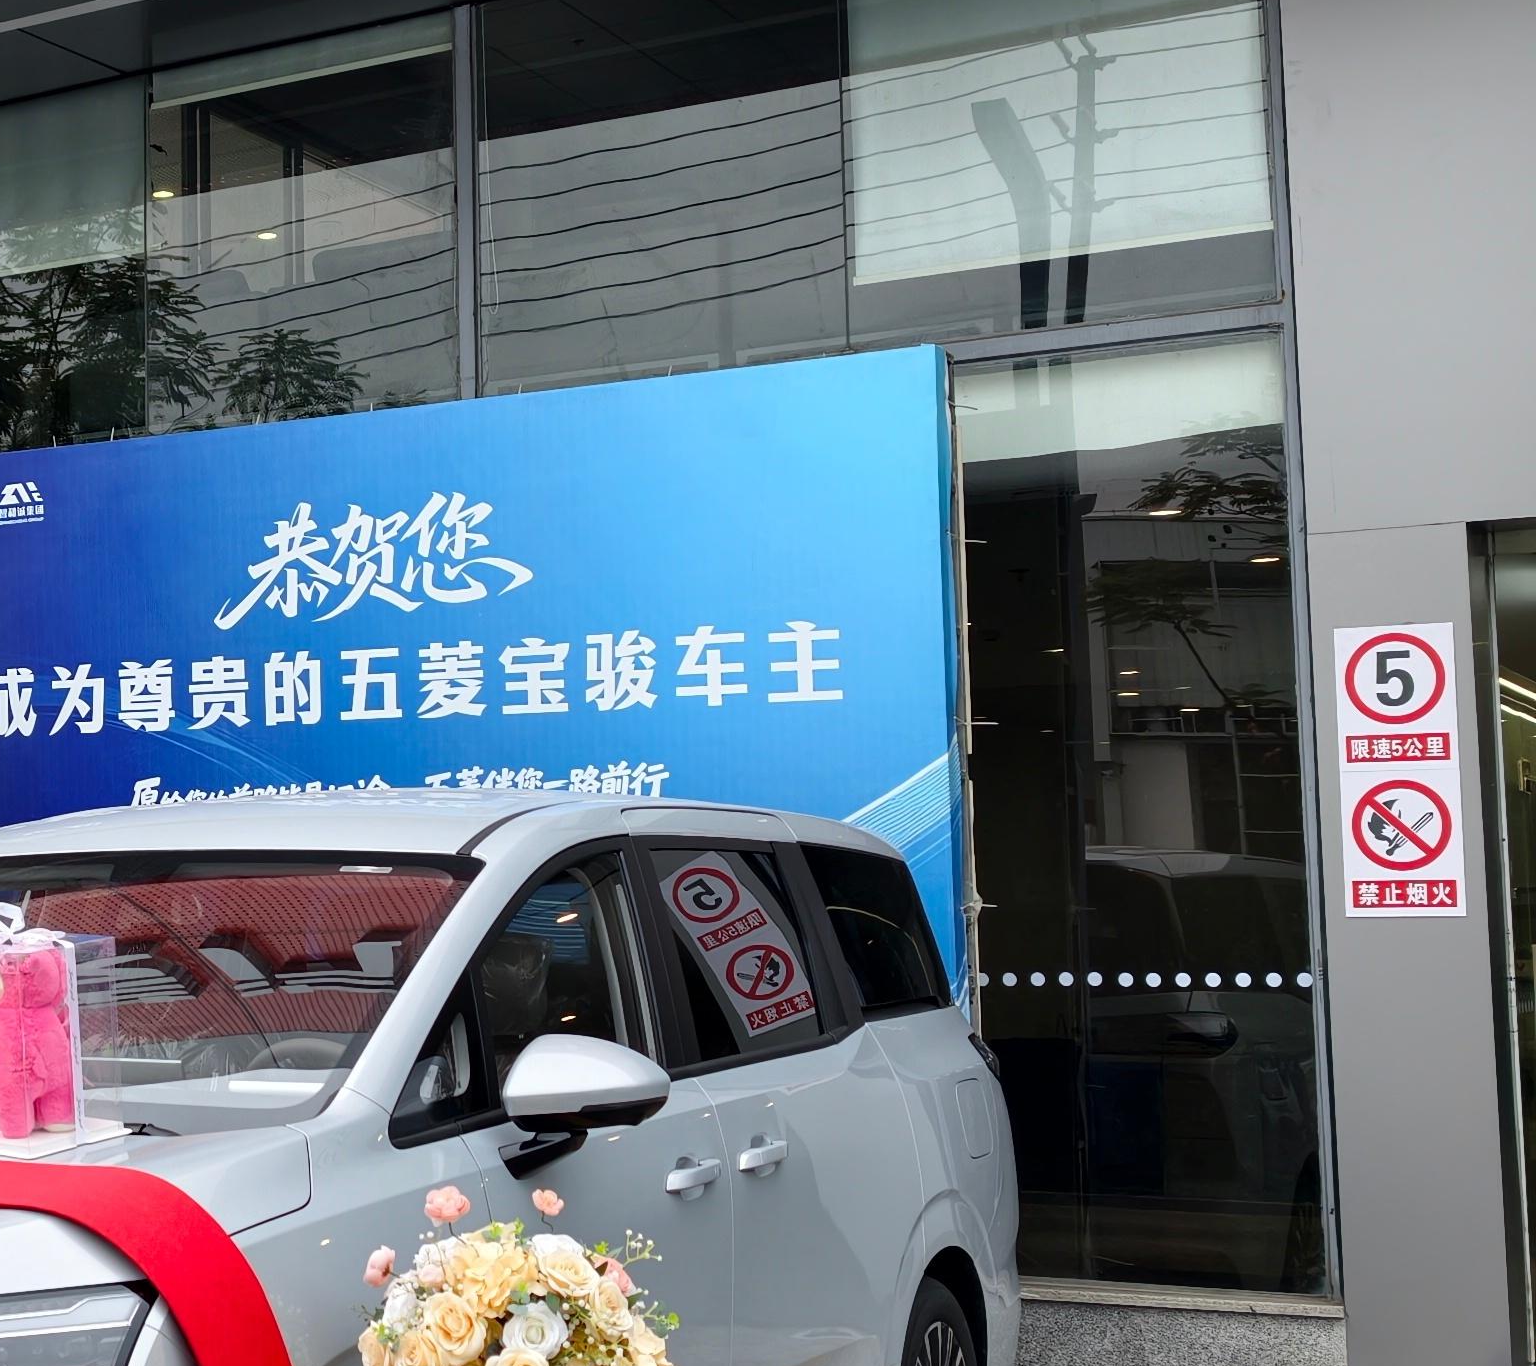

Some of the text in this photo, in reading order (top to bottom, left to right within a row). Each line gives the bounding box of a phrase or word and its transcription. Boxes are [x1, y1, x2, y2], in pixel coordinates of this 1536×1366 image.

[215, 490, 534, 630] 恭贺您
[1375, 649, 1415, 707] 5
[1350, 736, 1446, 761] 限速5公里
[1357, 881, 1453, 907] 禁止烟火
